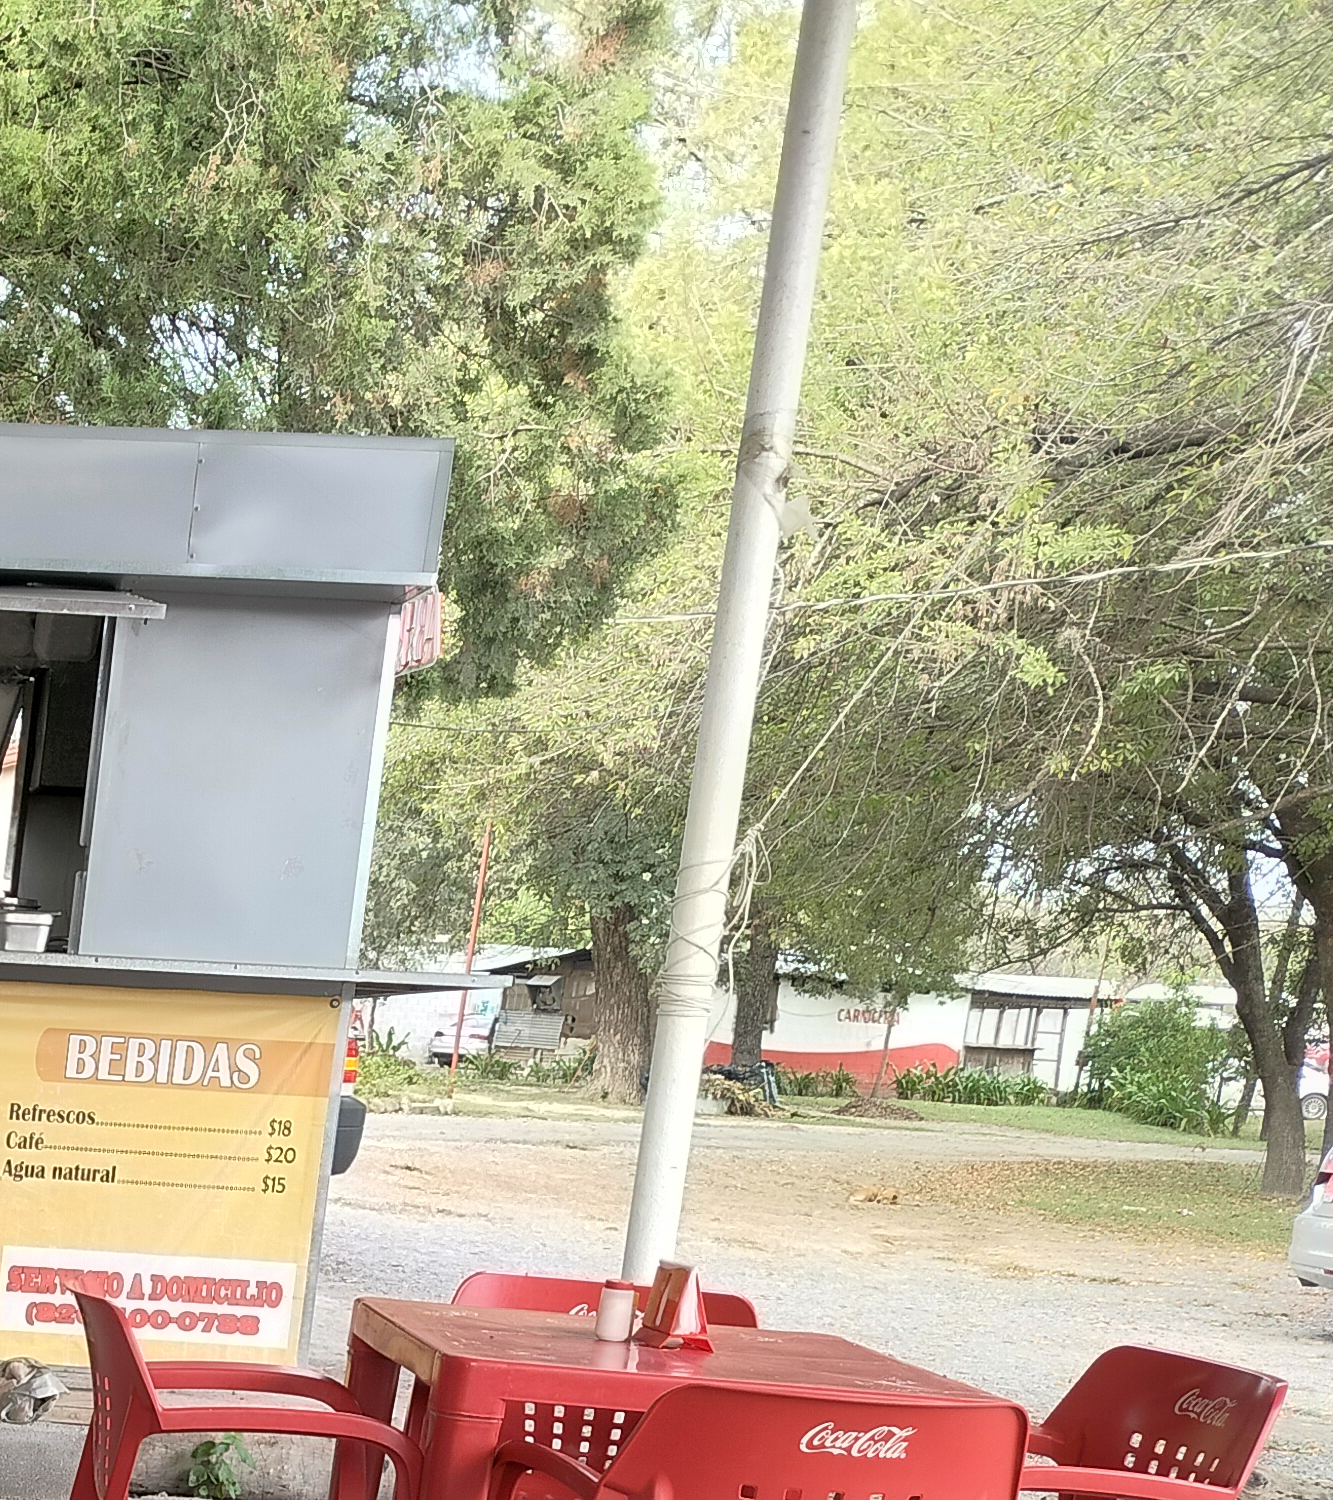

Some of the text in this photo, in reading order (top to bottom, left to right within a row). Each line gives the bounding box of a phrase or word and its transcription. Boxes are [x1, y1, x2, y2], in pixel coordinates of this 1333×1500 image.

[64, 1032, 263, 1090] BEBIDAS
[9, 1102, 293, 1139] Refrescos $18
[6, 1130, 297, 1166] Café $20
[1, 1158, 287, 1196] Agua natural $15
[6, 1265, 284, 1308] SERVIO A DOMICILIO
[1174, 1387, 1238, 1428] Coca-Cola
[800, 1420, 918, 1461] Coca-Cola
